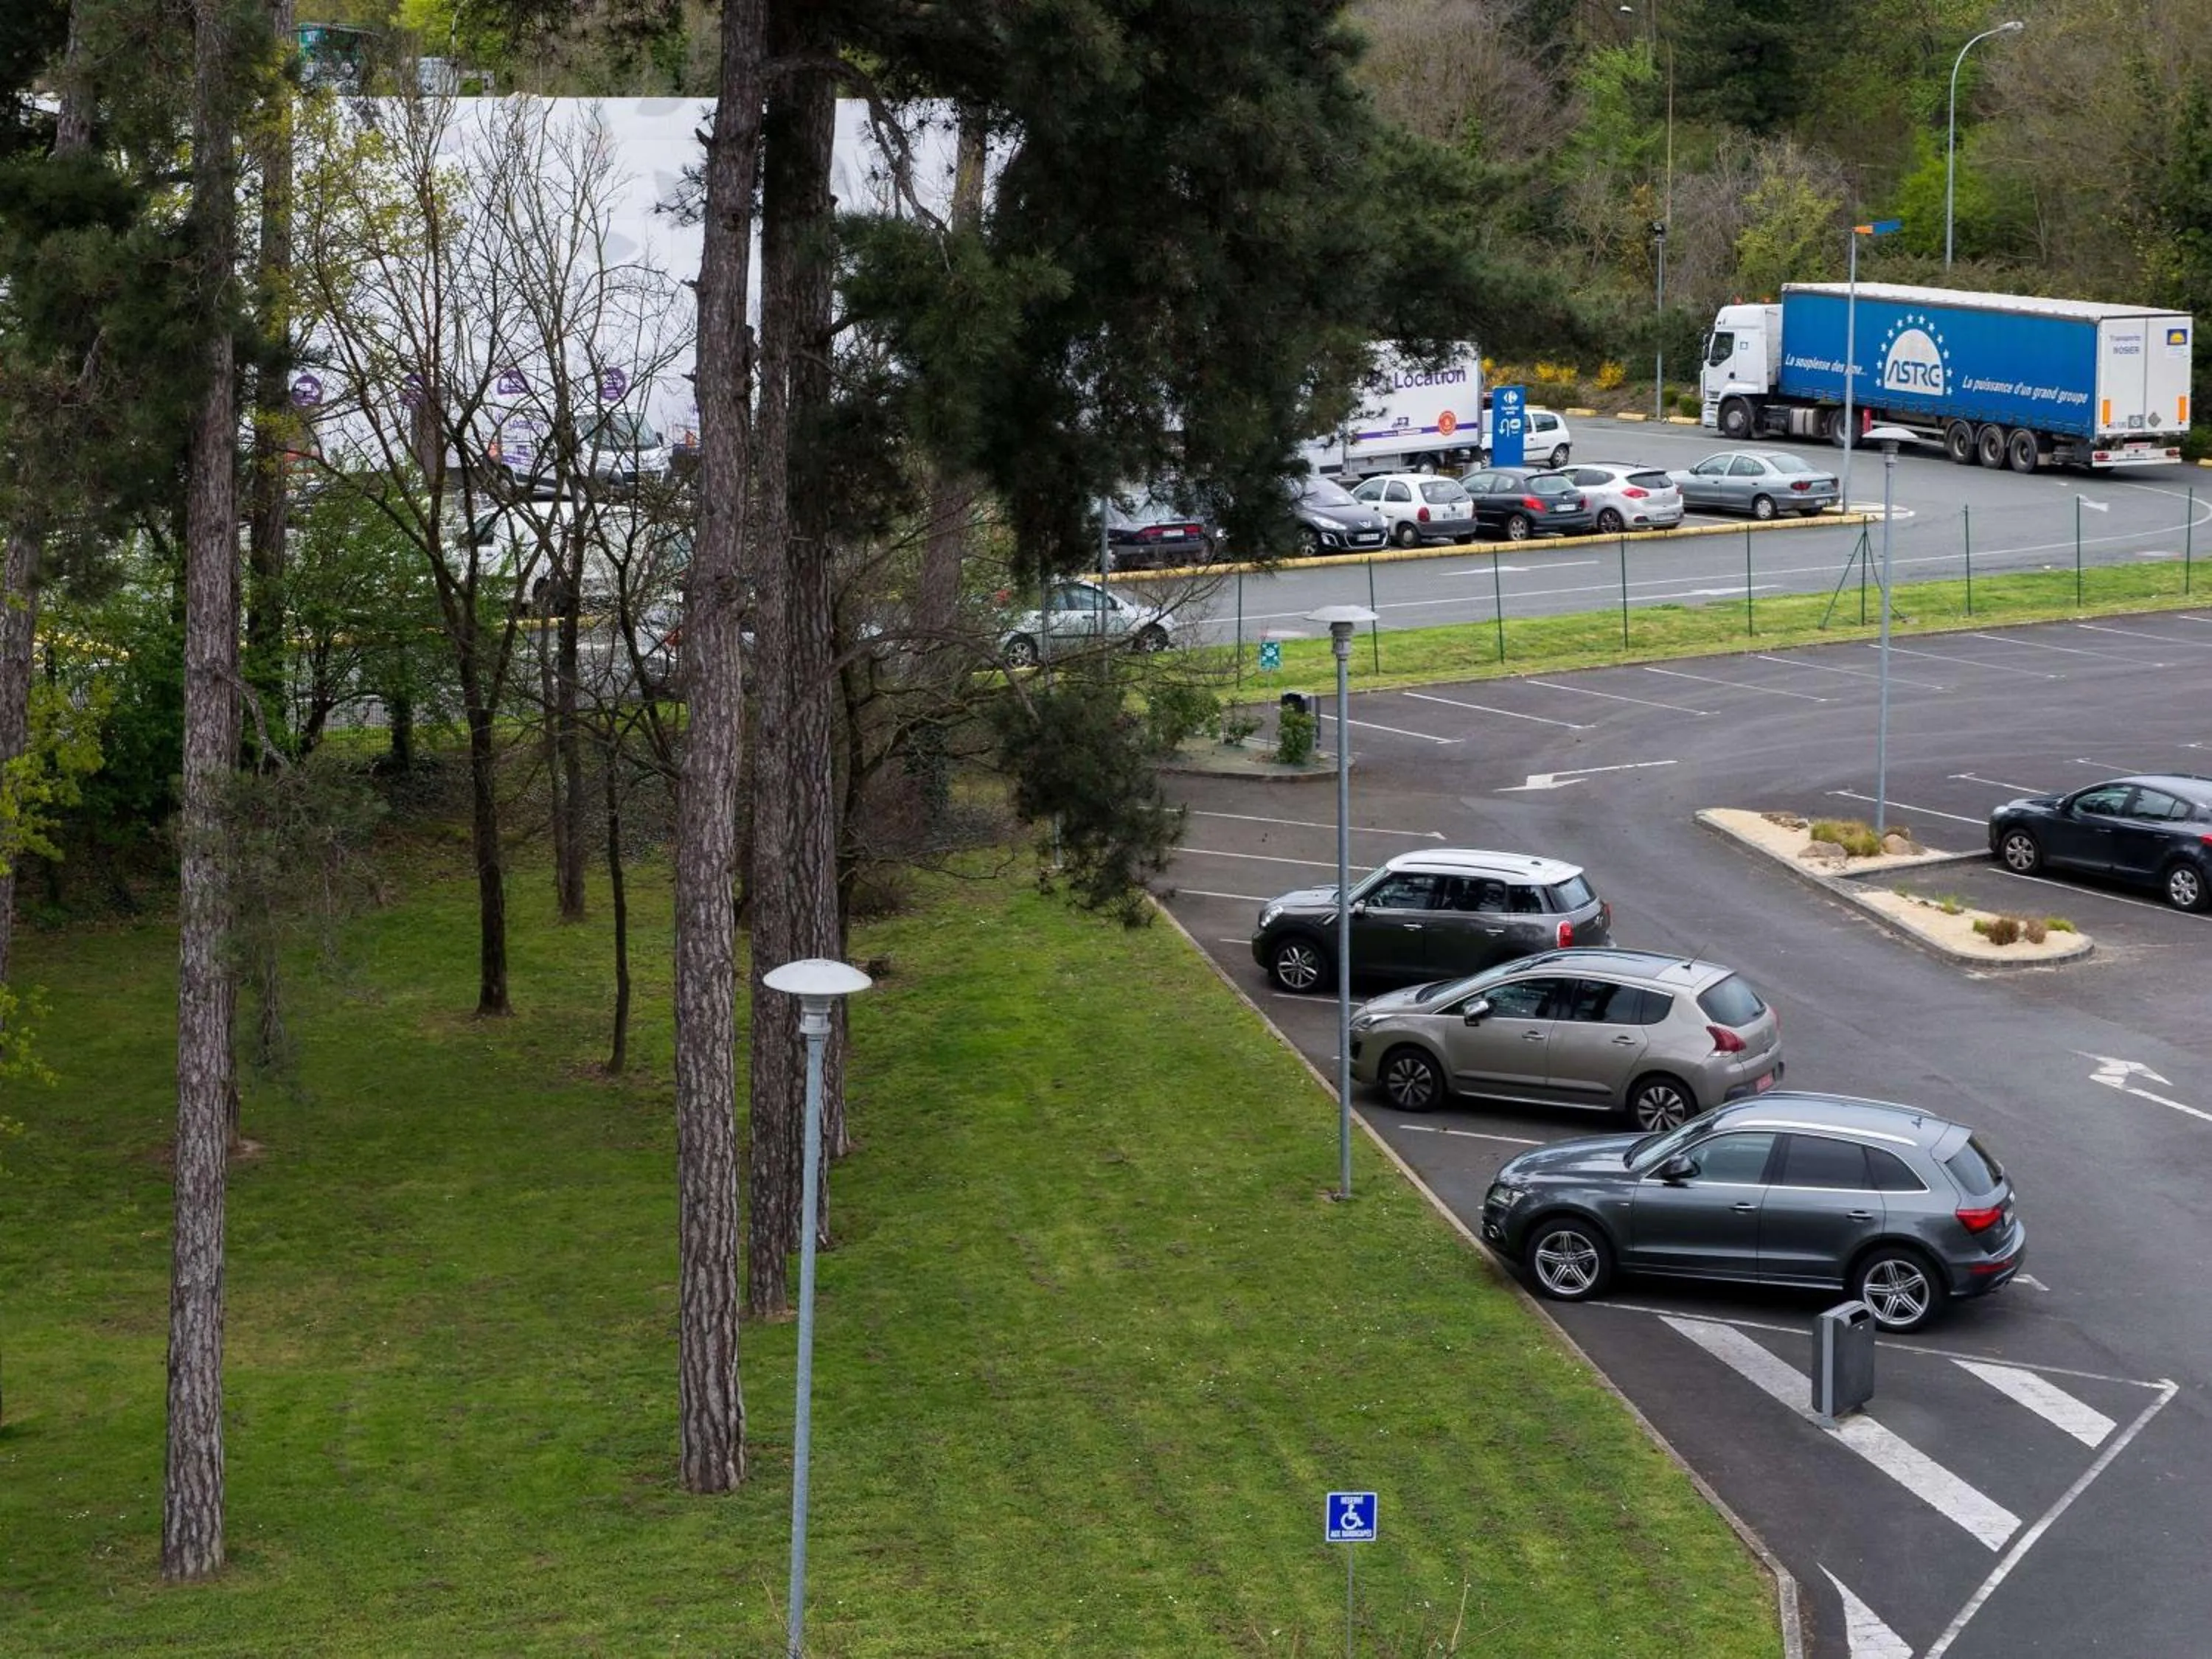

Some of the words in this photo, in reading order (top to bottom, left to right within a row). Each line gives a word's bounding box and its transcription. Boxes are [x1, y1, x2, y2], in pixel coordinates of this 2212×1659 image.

[1785, 353, 1795, 366] La
[1394, 368, 1467, 389] Location
[1887, 359, 1941, 388] ASTRE
[1961, 375, 1973, 389] La
[1972, 377, 2014, 394] puissance
[2014, 380, 2032, 397] d'un
[2031, 386, 2059, 401] grand
[2056, 389, 2089, 406] groupe
